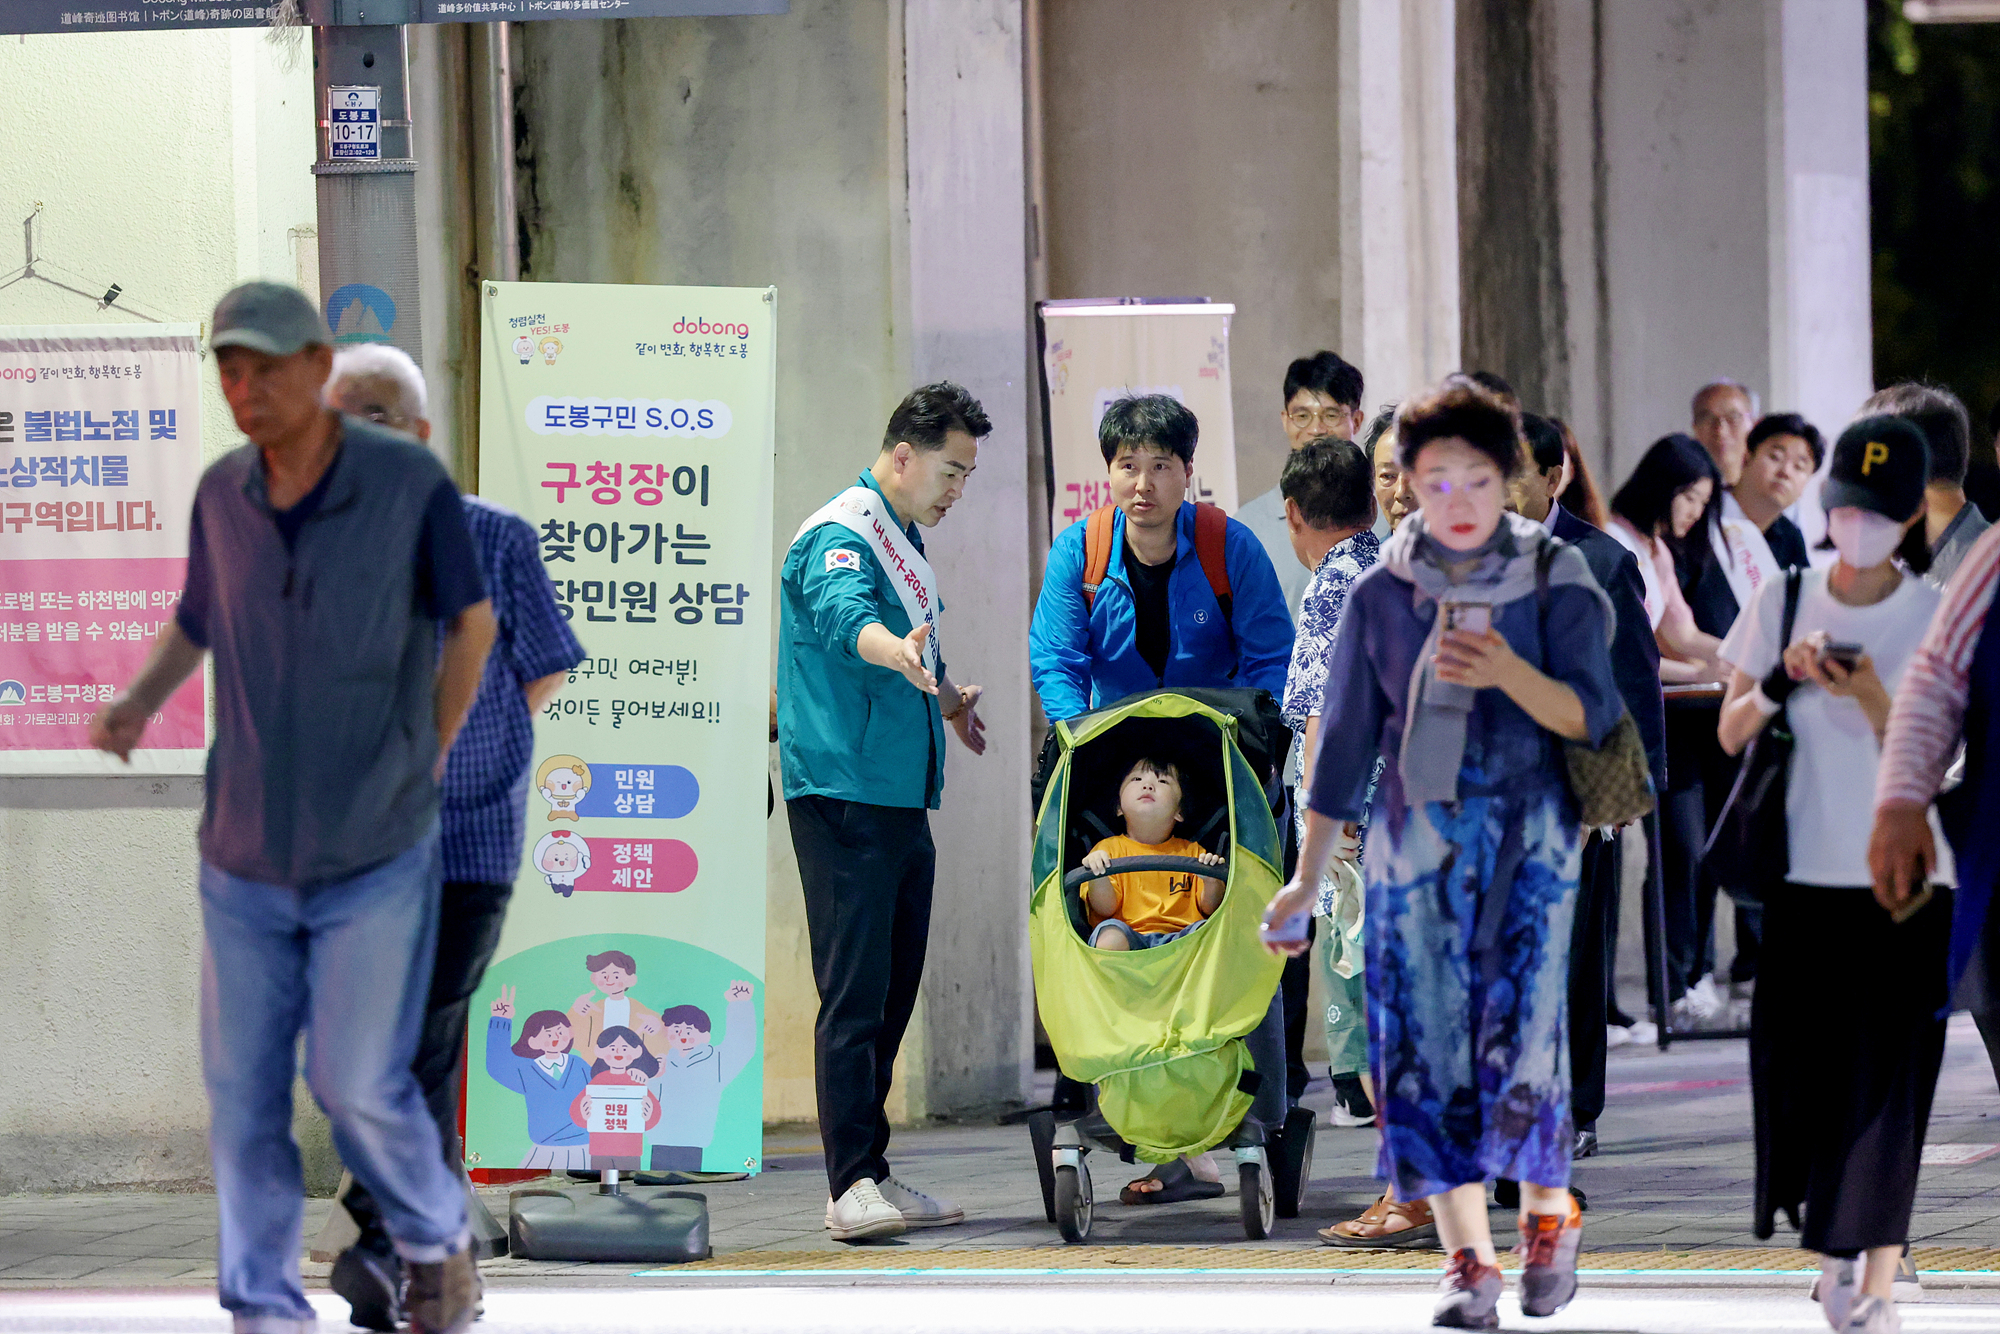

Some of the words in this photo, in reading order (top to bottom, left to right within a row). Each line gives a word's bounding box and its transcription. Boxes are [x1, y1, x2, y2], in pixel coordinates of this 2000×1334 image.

[438, 2, 516, 14] 道峰多价值共享中心
[339, 110, 370, 121] 도봉로
[335, 124, 374, 140] 10-17
[508, 313, 546, 329] 청렴실천
[530, 325, 551, 336] YES!
[553, 323, 570, 334] 도봉
[673, 317, 749, 339] dobong
[635, 343, 656, 356] 같이
[660, 342, 687, 358] 변화,
[689, 343, 725, 358] 행복한
[729, 343, 749, 359] 도봉
[40, 367, 59, 379] 같이
[62, 365, 87, 380] 변화,
[89, 364, 121, 379] 행복한
[124, 364, 142, 380] 도봉
[24, 410, 140, 442] 불법노점
[149, 409, 177, 441] 및
[544, 405, 637, 430] 도봉구민
[645, 408, 714, 431] S.O.S
[1861, 441, 1890, 476] P
[541, 461, 710, 507] 구청장이
[0, 501, 163, 534] 구역입니다.
[540, 518, 711, 566] 찾아가는
[872, 518, 929, 609] 도봉구청장
[0, 591, 35, 611] 로법
[40, 592, 74, 611] 또는
[78, 590, 147, 611] 하천법에
[551, 579, 657, 624] 장민원
[669, 581, 750, 625] 상담
[46, 622, 81, 642] 받을
[85, 622, 104, 641] 수
[108, 620, 169, 641] 있습니
[629, 659, 698, 686] 여러분!
[30, 684, 116, 703] 도봉구청장
[25, 712, 80, 726] 가로관리과
[543, 699, 600, 725] 엇이든
[611, 698, 721, 729] 물어보세요!!
[615, 768, 655, 790] 민원
[613, 793, 656, 814] 상담
[612, 843, 654, 865] 정책
[611, 868, 654, 889] 제안
[605, 1104, 628, 1116] 민원
[604, 1118, 628, 1131] 정책
